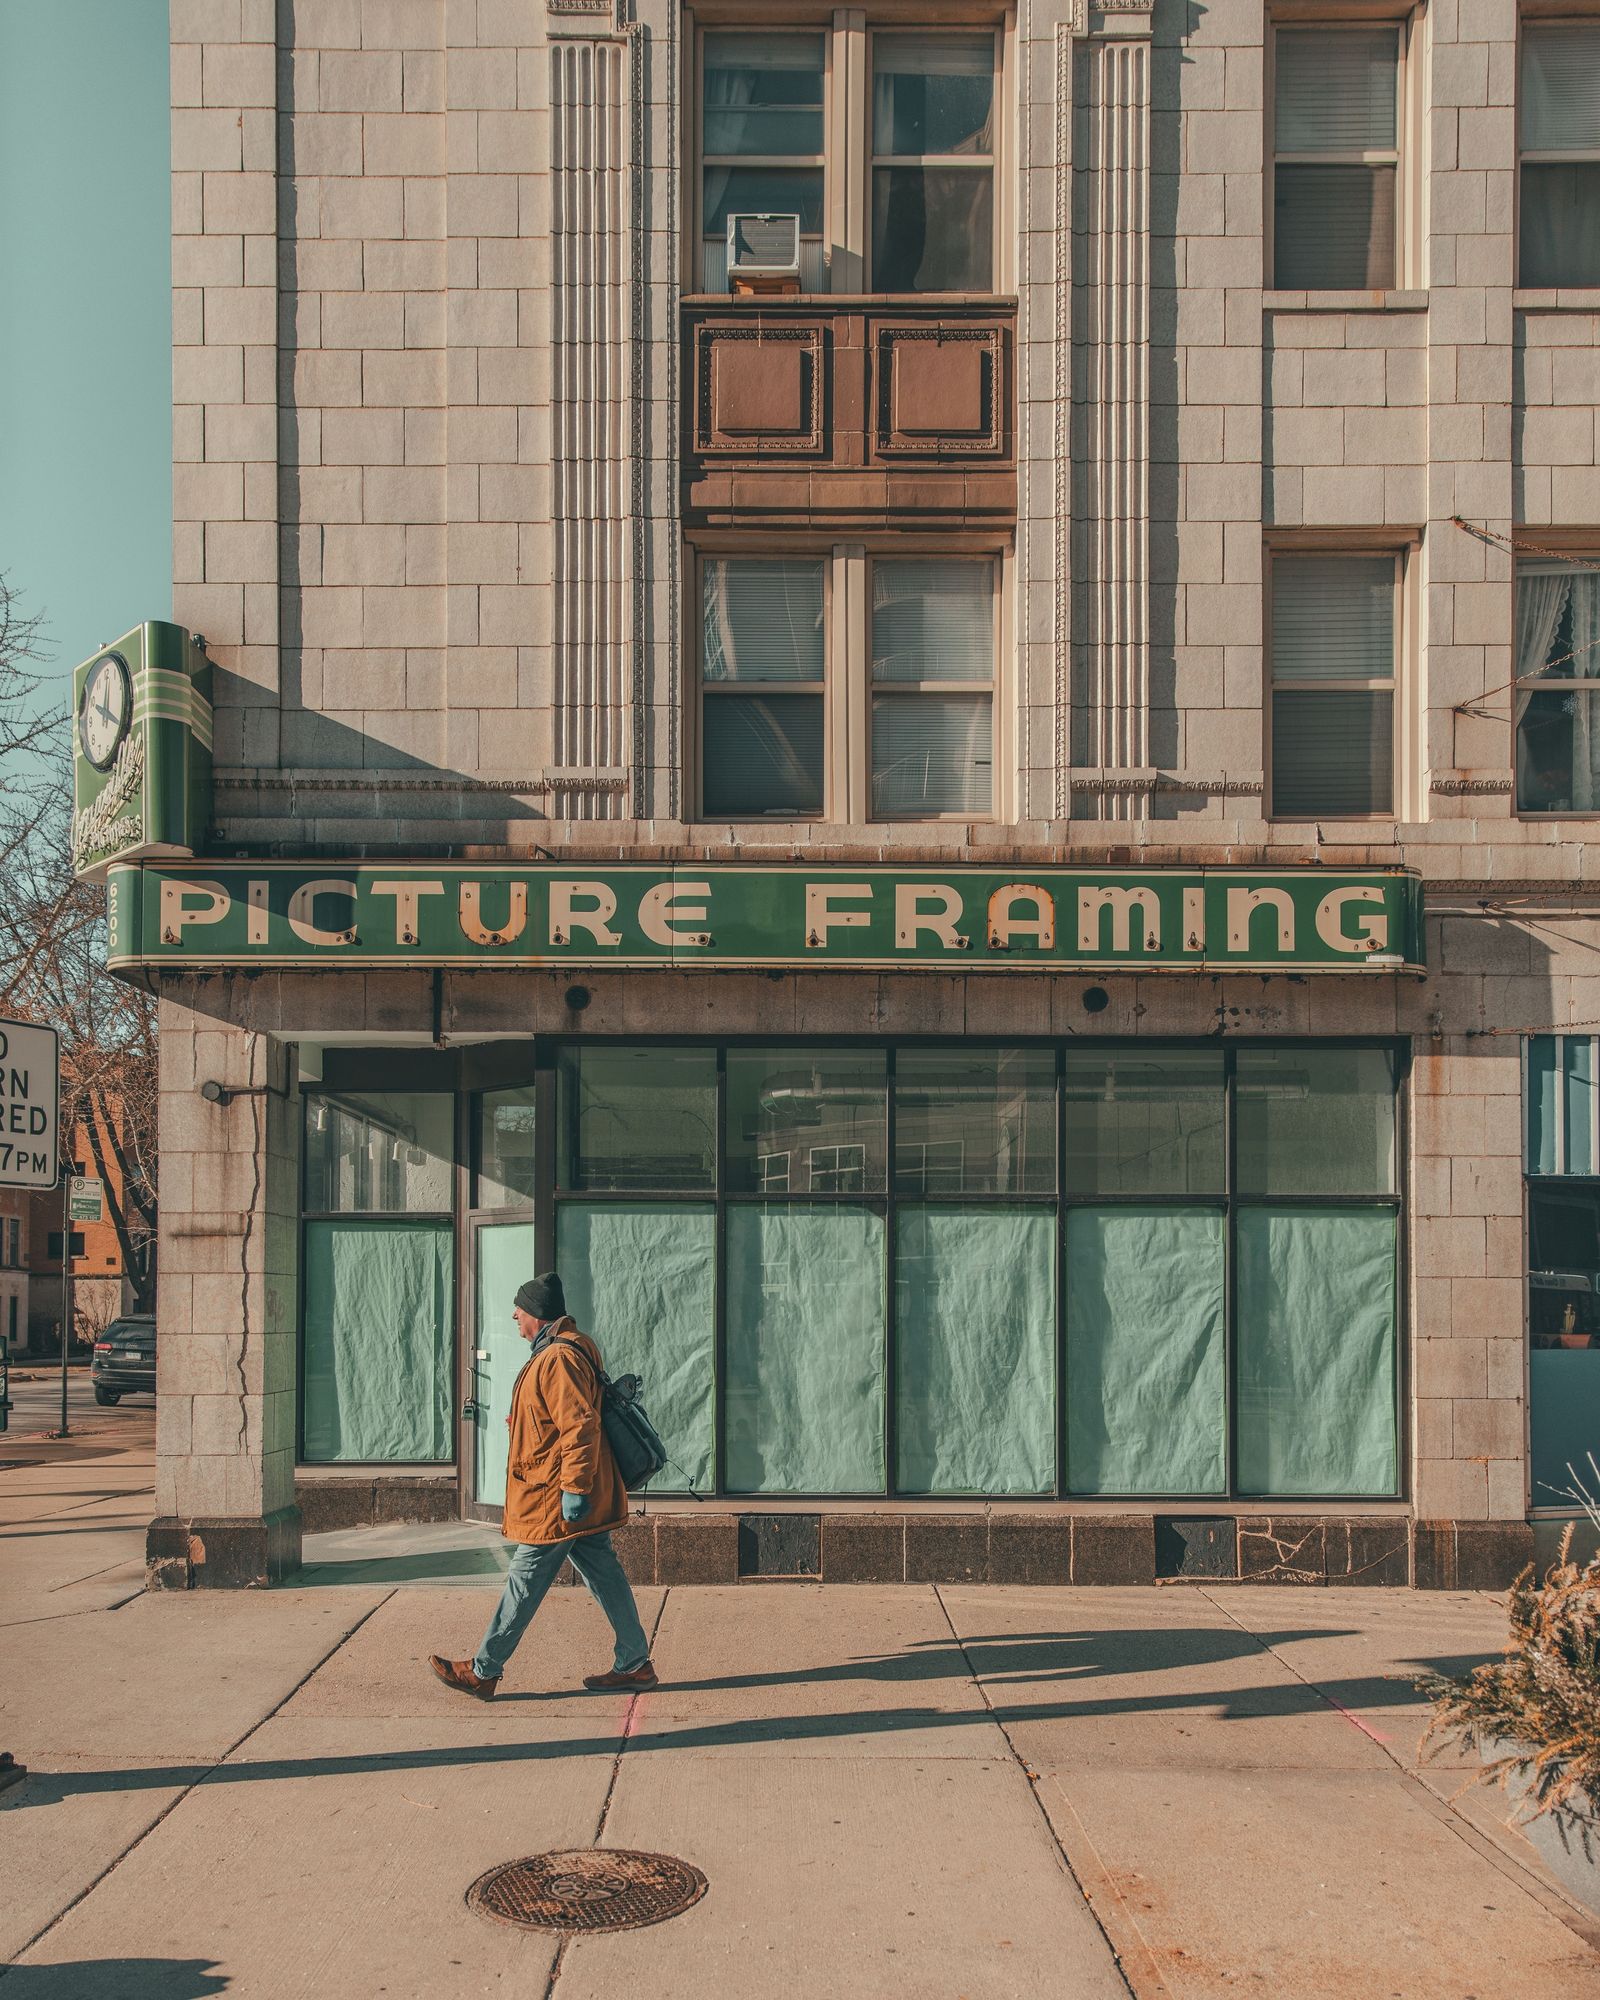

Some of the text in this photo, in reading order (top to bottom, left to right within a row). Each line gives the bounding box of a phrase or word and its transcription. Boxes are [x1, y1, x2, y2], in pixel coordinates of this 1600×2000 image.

[110, 882, 118, 947] 6200
[160, 880, 1388, 953] PICTURE FRAMING
